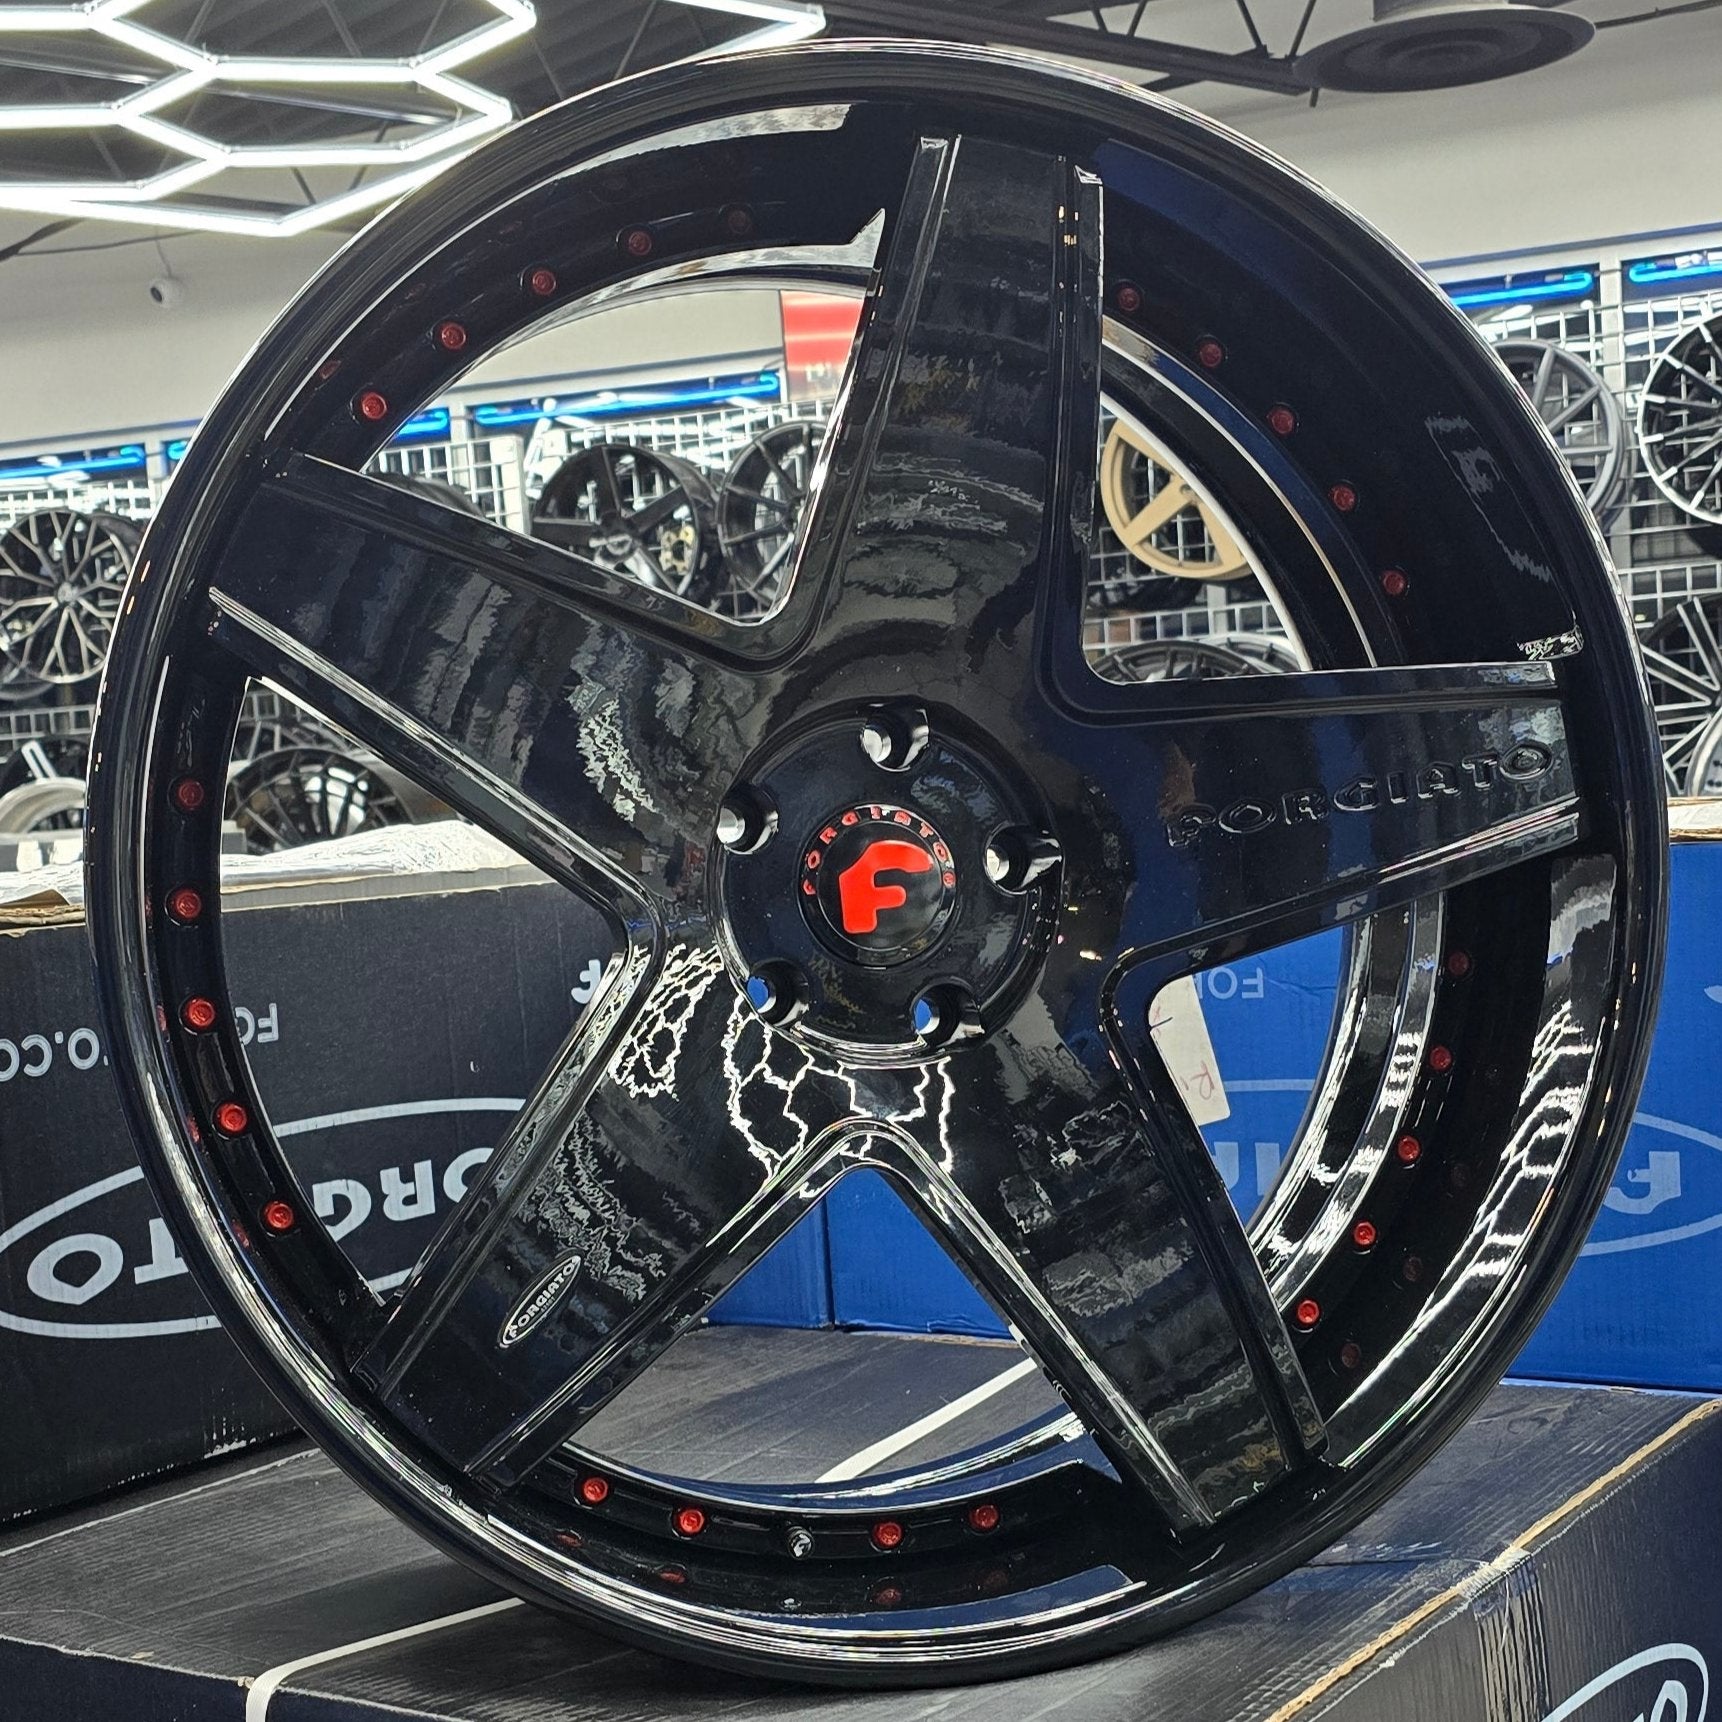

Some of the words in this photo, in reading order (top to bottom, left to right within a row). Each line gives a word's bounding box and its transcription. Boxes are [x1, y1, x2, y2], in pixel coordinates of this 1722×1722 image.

[1166, 741, 1555, 848] FORGIATO
[839, 839, 934, 934] F
[508, 1262, 575, 1338] FORGIATO
